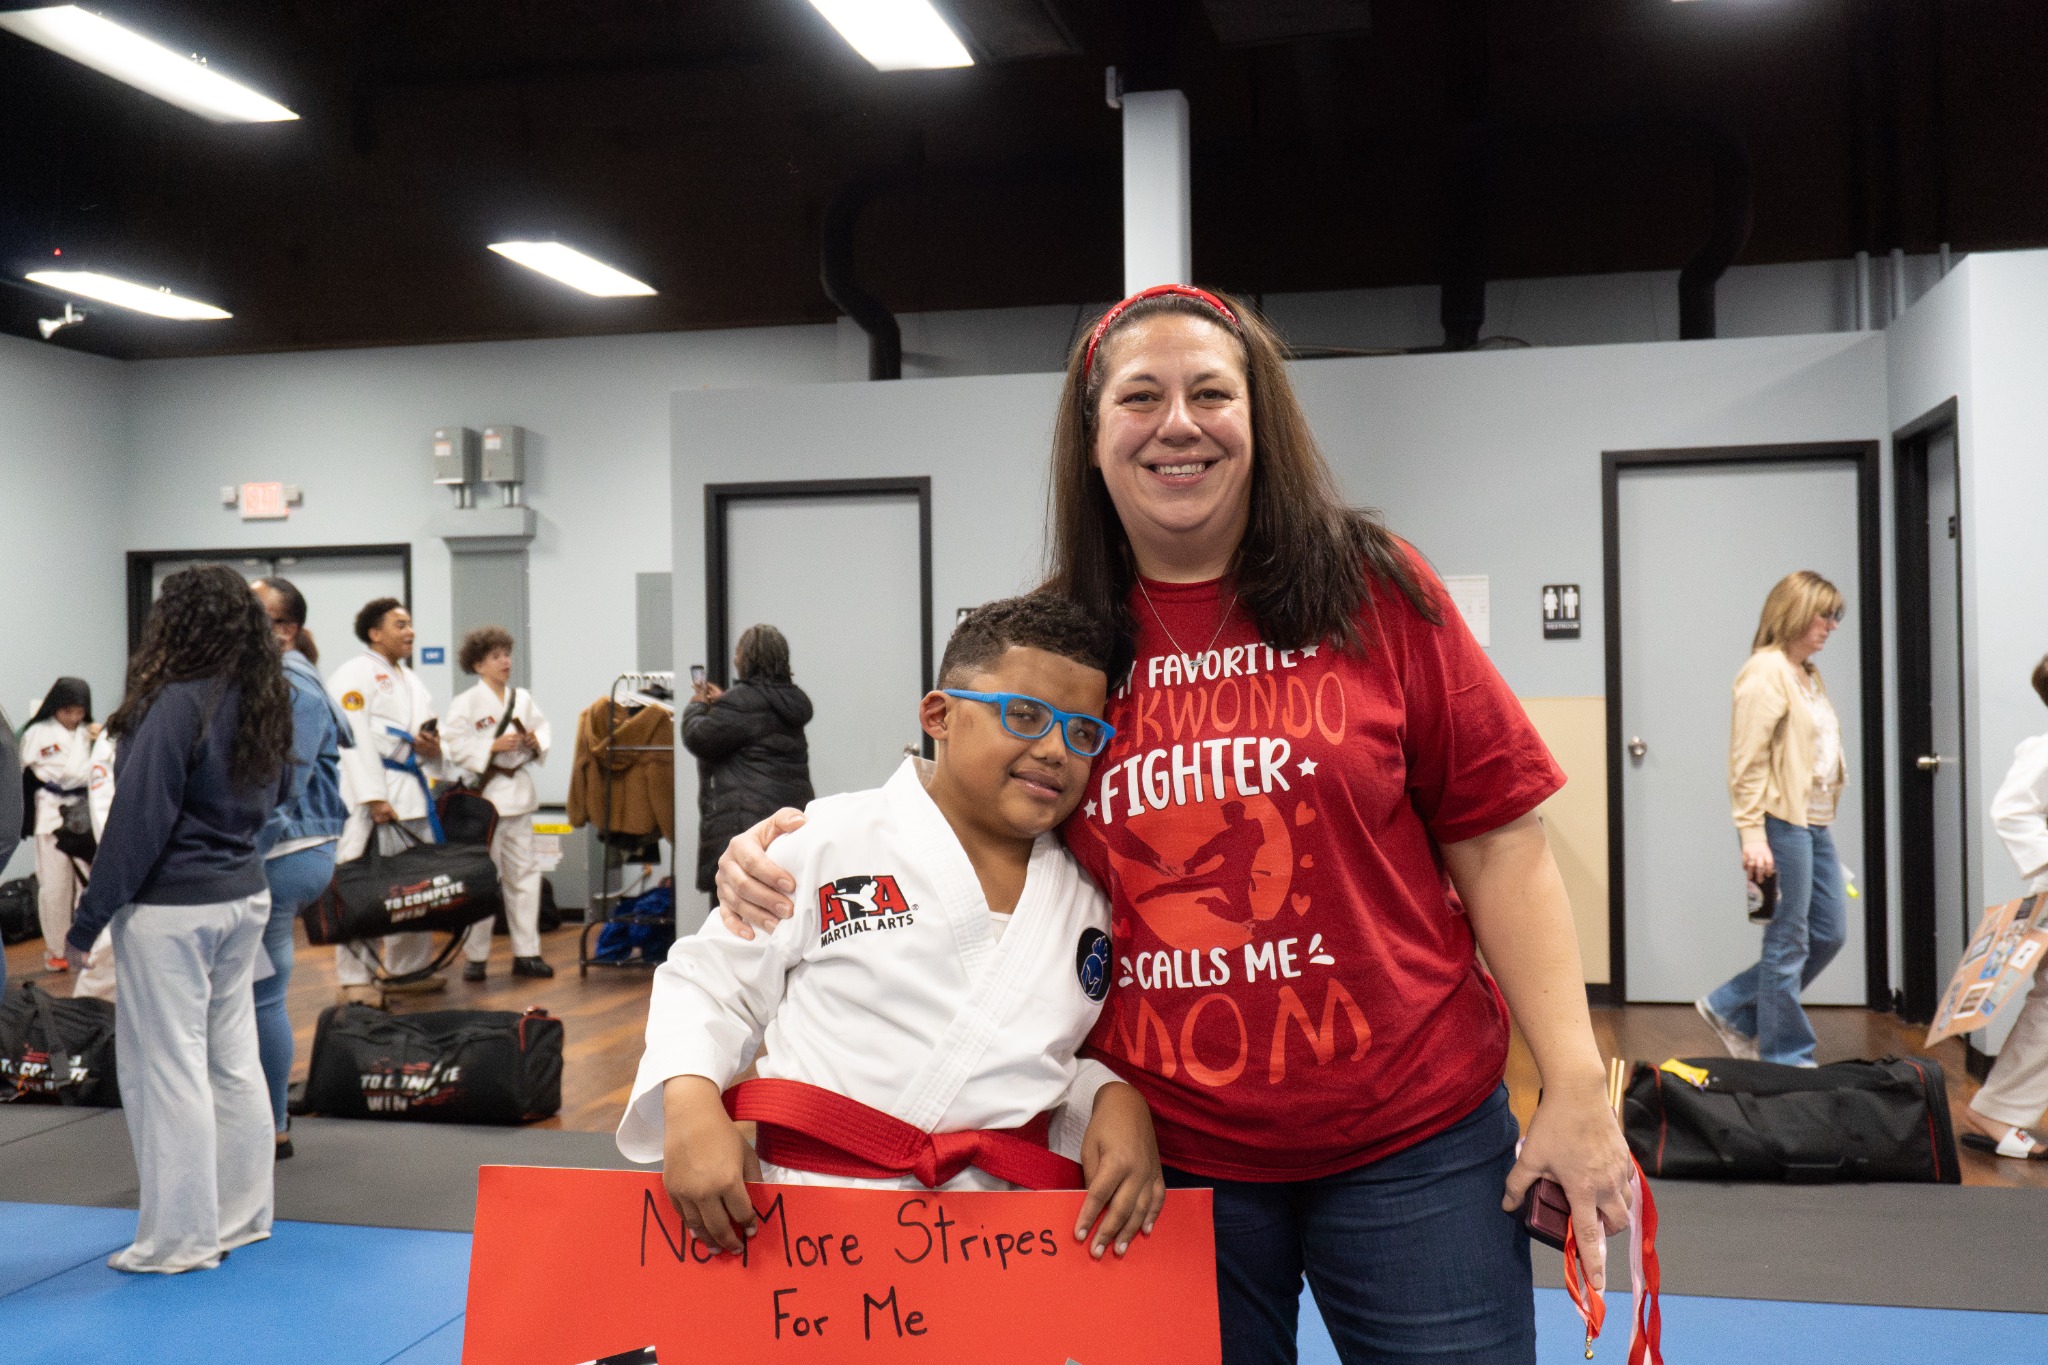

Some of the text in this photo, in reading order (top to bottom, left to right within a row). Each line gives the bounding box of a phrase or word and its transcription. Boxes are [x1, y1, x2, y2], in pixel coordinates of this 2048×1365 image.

[1148, 642, 1298, 688] FAVORITE
[1100, 736, 1292, 825] FIGHTER
[820, 913, 914, 948] MARTIAL ARTS
[1136, 937, 1302, 990] CALLS ME
[1103, 978, 1373, 1087] MOM
[742, 1192, 864, 1268] More
[894, 1198, 1058, 1271] Stripes
[773, 1285, 928, 1341] For Me
